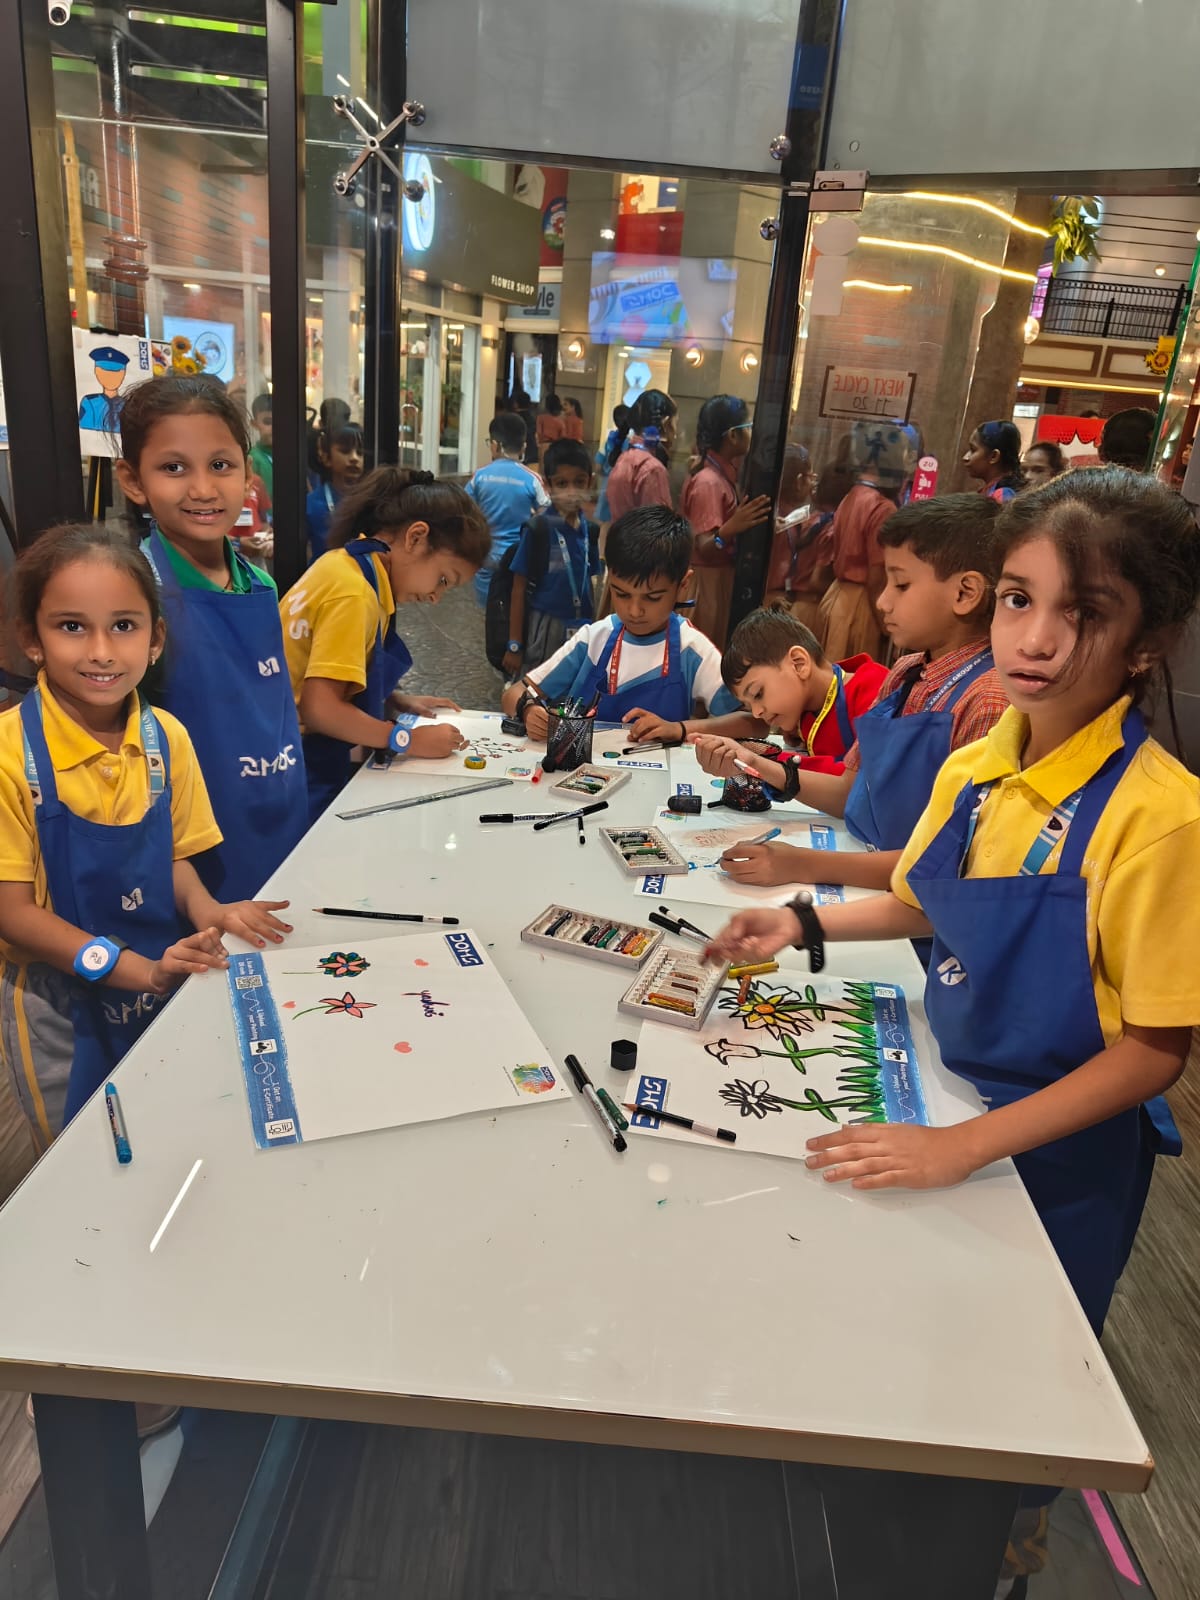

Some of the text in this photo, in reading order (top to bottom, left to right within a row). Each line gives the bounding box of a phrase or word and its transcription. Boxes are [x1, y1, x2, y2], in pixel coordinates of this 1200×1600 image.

[491, 274, 535, 296] FLOWER SHOP
[528, 286, 555, 310] yle
[140, 342, 149, 370] DOMS
[952, 664, 973, 681] GROUP
[645, 874, 664, 894] DOM
[449, 934, 480, 965] DOMS
